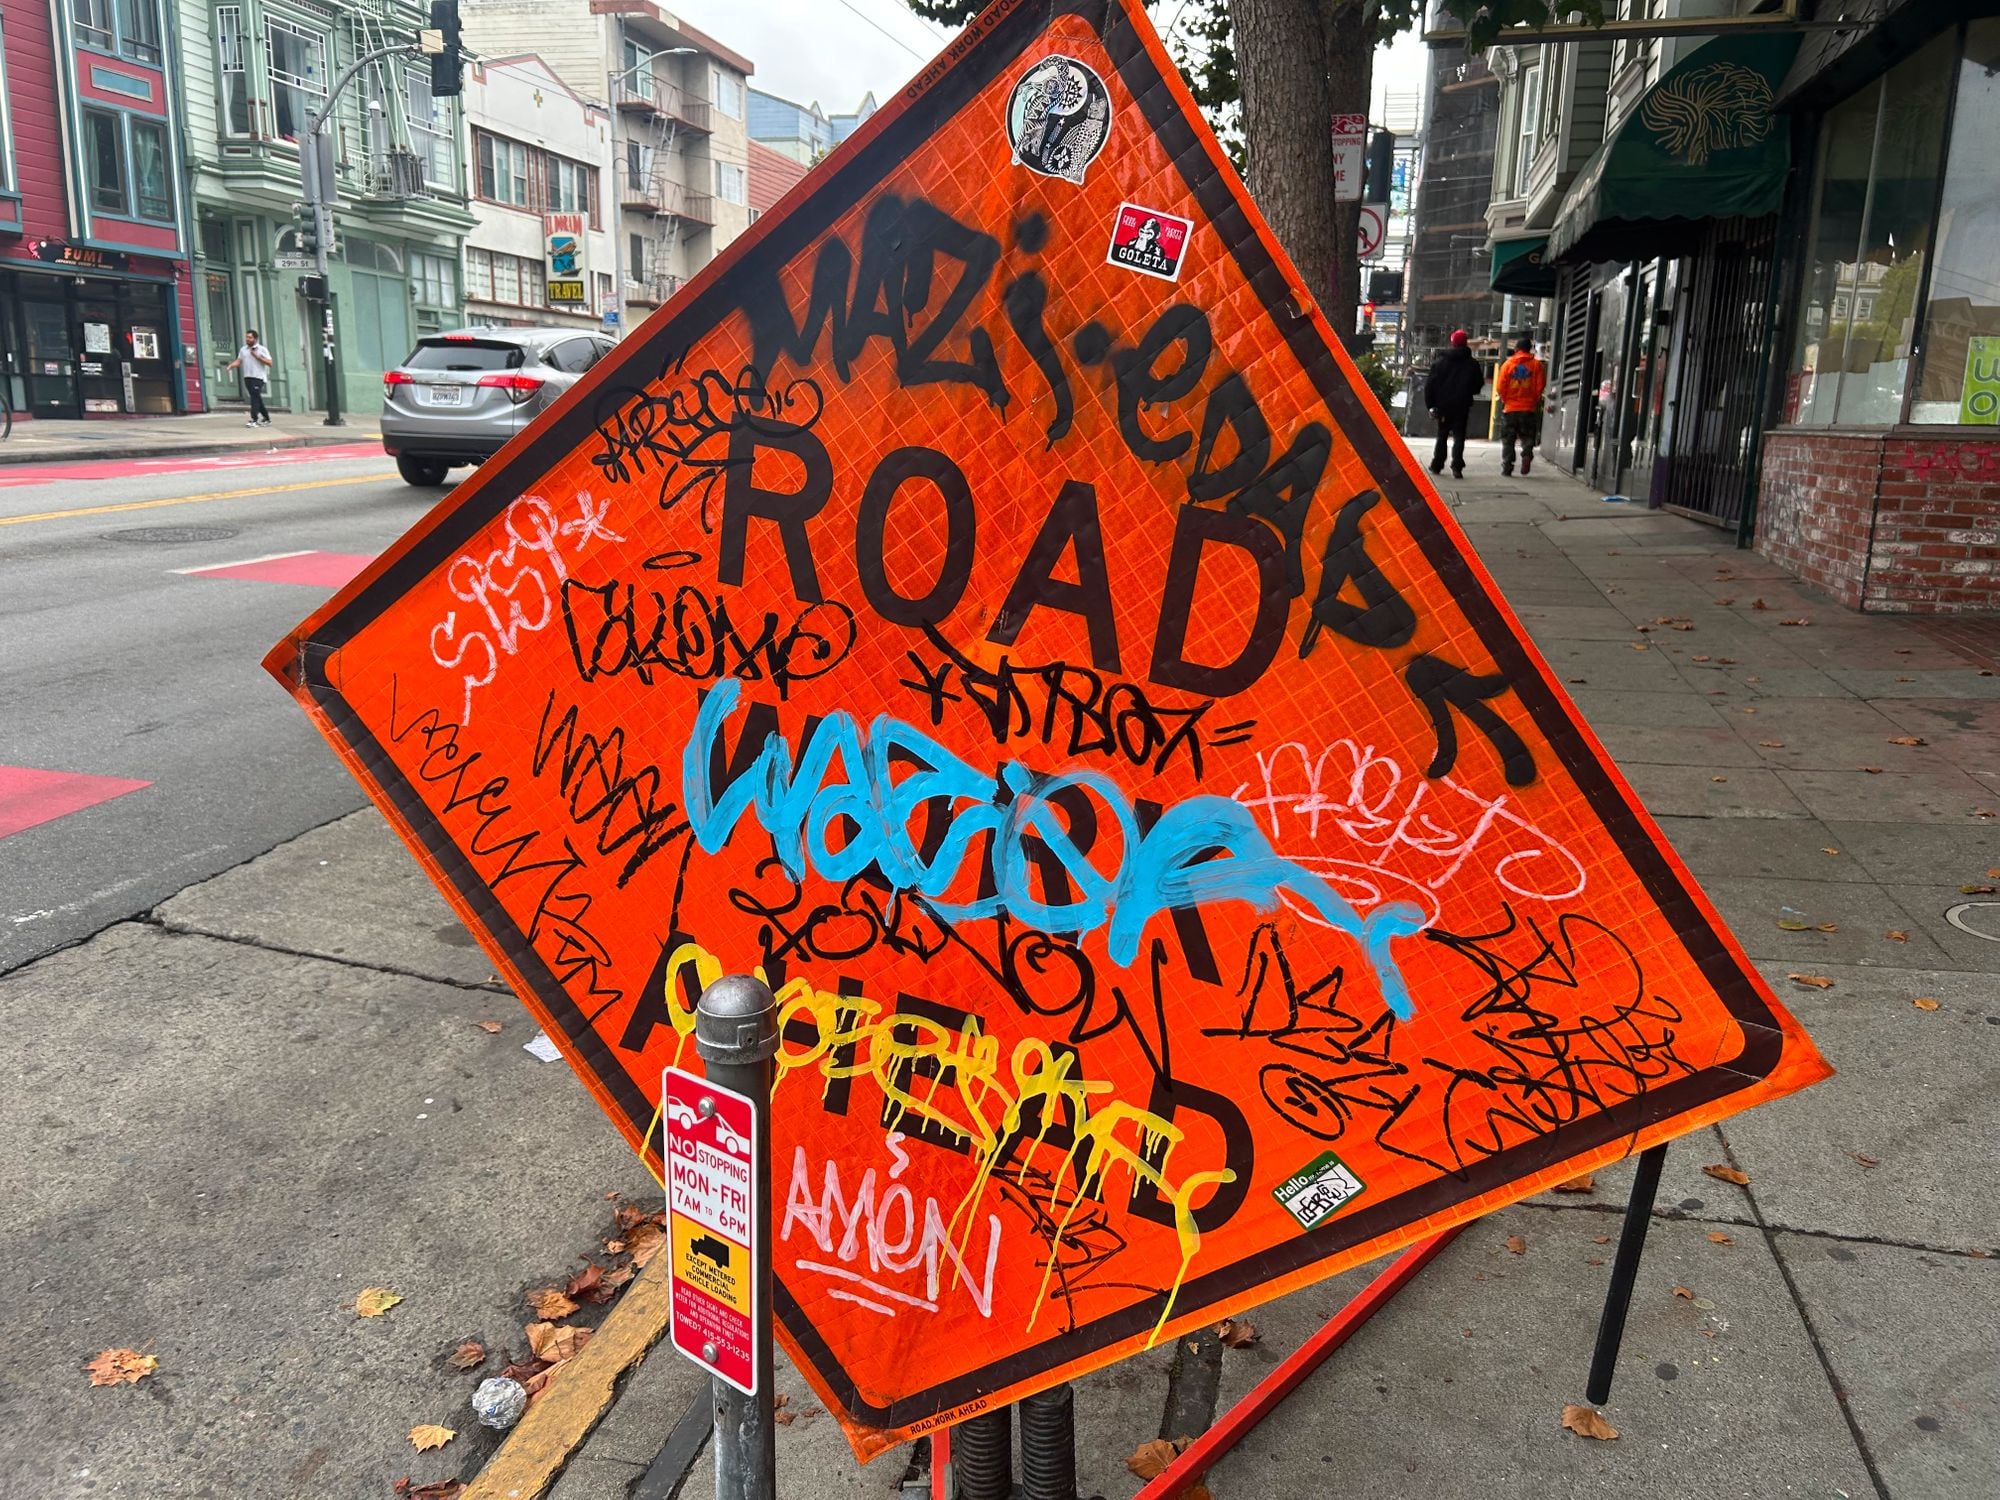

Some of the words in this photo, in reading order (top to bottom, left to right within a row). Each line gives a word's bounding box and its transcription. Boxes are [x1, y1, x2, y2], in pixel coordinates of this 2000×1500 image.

[948, 26, 983, 60] WORK
[906, 58, 946, 98] AHEAD
[1333, 137, 1361, 146] TOPPING
[1333, 153, 1345, 164] NY
[64, 247, 103, 263] FUMI
[281, 259, 297, 268] 29th
[300, 260, 309, 268] St
[1118, 247, 1167, 271] GOLETA
[548, 282, 583, 300] TRAVEL
[718, 411, 1290, 697] ROAD
[669, 1132, 695, 1158] NO
[698, 1149, 747, 1183] STOPPING
[1274, 1175, 1309, 1202] Hello
[675, 1186, 700, 1214] 7AM
[705, 1206, 713, 1216] TO
[719, 1210, 746, 1237] 6PM
[686, 1253, 707, 1269] EXCEPT
[709, 1266, 736, 1285] METERED
[691, 1265, 730, 1292] COMMERCIAL
[685, 1270, 709, 1289] VEHICLE
[711, 1285, 737, 1304] LOADING
[688, 1299, 697, 1309] FOR
[697, 1303, 720, 1324] ADDITIONAL
[721, 1317, 750, 1340] REGULATIONS
[692, 1291, 706, 1306] OTHER
[706, 1299, 718, 1313] SIGNS
[719, 1307, 728, 1318] AND
[729, 1312, 743, 1327] CHECK
[675, 1311, 702, 1331] TOWED?
[702, 1327, 751, 1362] 415-553-1235
[722, 1327, 734, 1340] TIMES
[910, 1420, 932, 1435] ROAD
[934, 1411, 956, 1425] WORK
[958, 1399, 987, 1417] AHEAD
